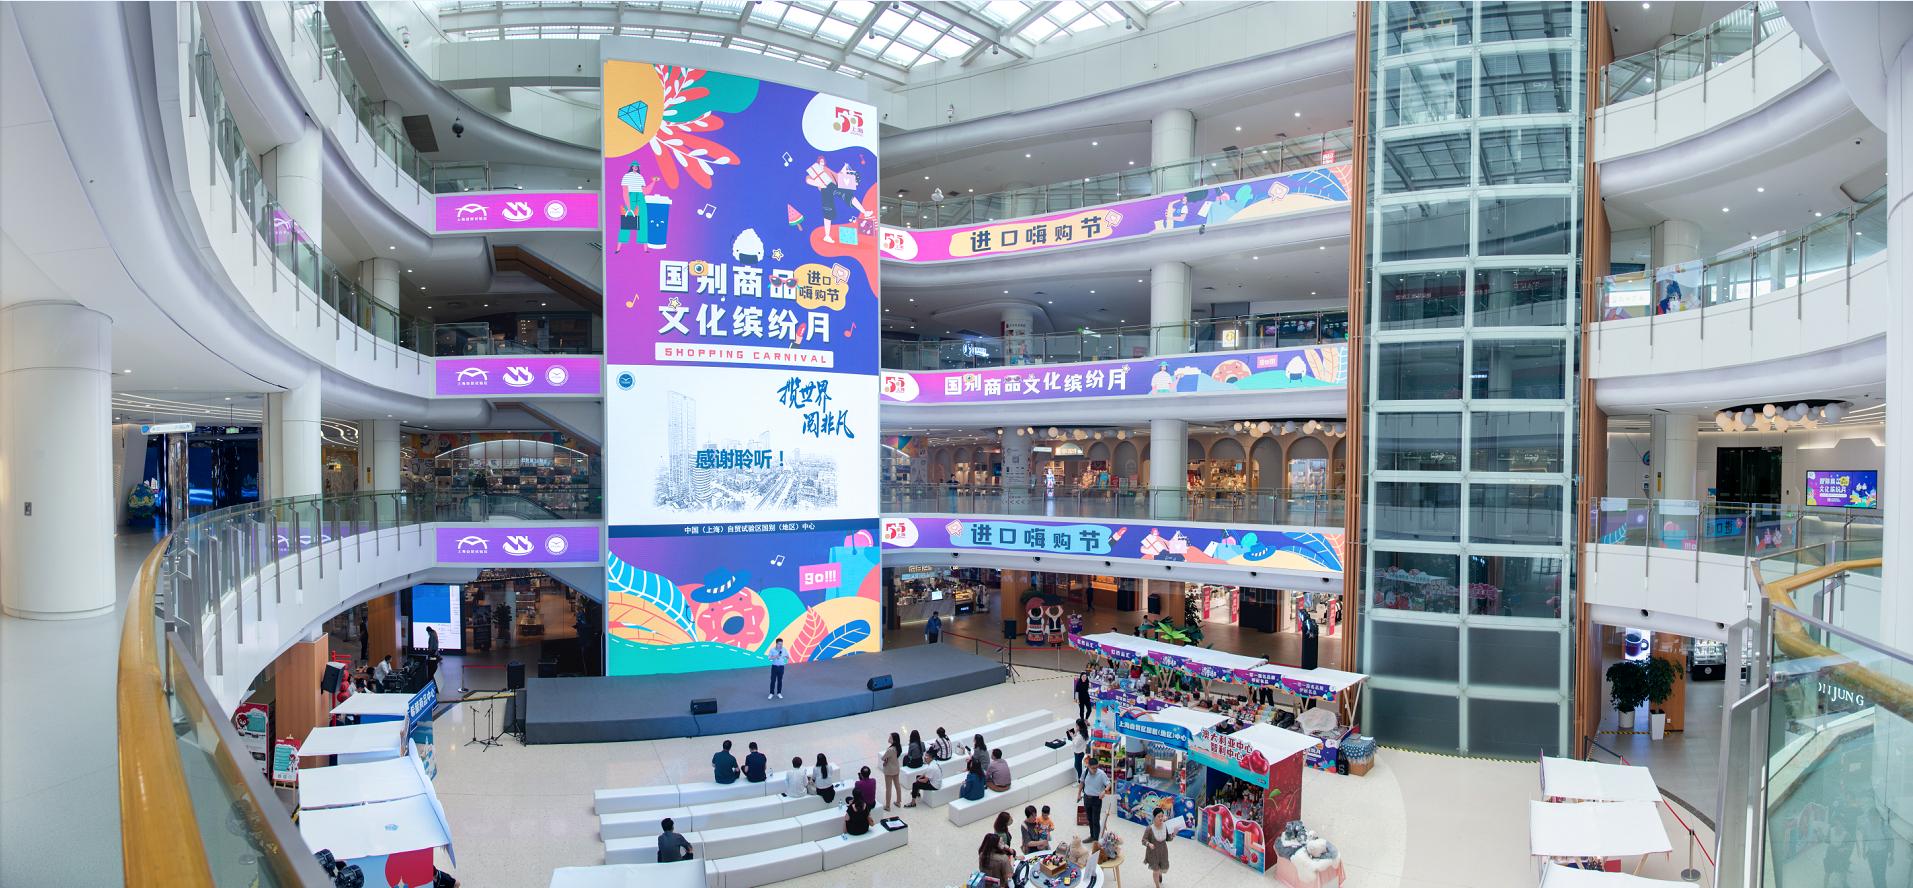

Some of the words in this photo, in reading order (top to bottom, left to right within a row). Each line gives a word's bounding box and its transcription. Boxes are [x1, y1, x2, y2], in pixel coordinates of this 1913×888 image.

[969, 216, 1104, 253] 进口嗨购节
[659, 259, 796, 300] 国别商品
[807, 270, 832, 286] 进口
[799, 287, 840, 302] 嗨购节
[658, 303, 831, 343] 文化缤纷月
[664, 348, 744, 359] SHOPPING
[753, 352, 827, 363] CARNIVAL
[944, 367, 1128, 397] 国别商品文化缤纷月
[695, 448, 784, 470] 感谢聆听！
[970, 523, 1101, 552] 进口嗨购节
[804, 570, 837, 585] go!!!
[1201, 728, 1253, 754] 澳大利亚中心
